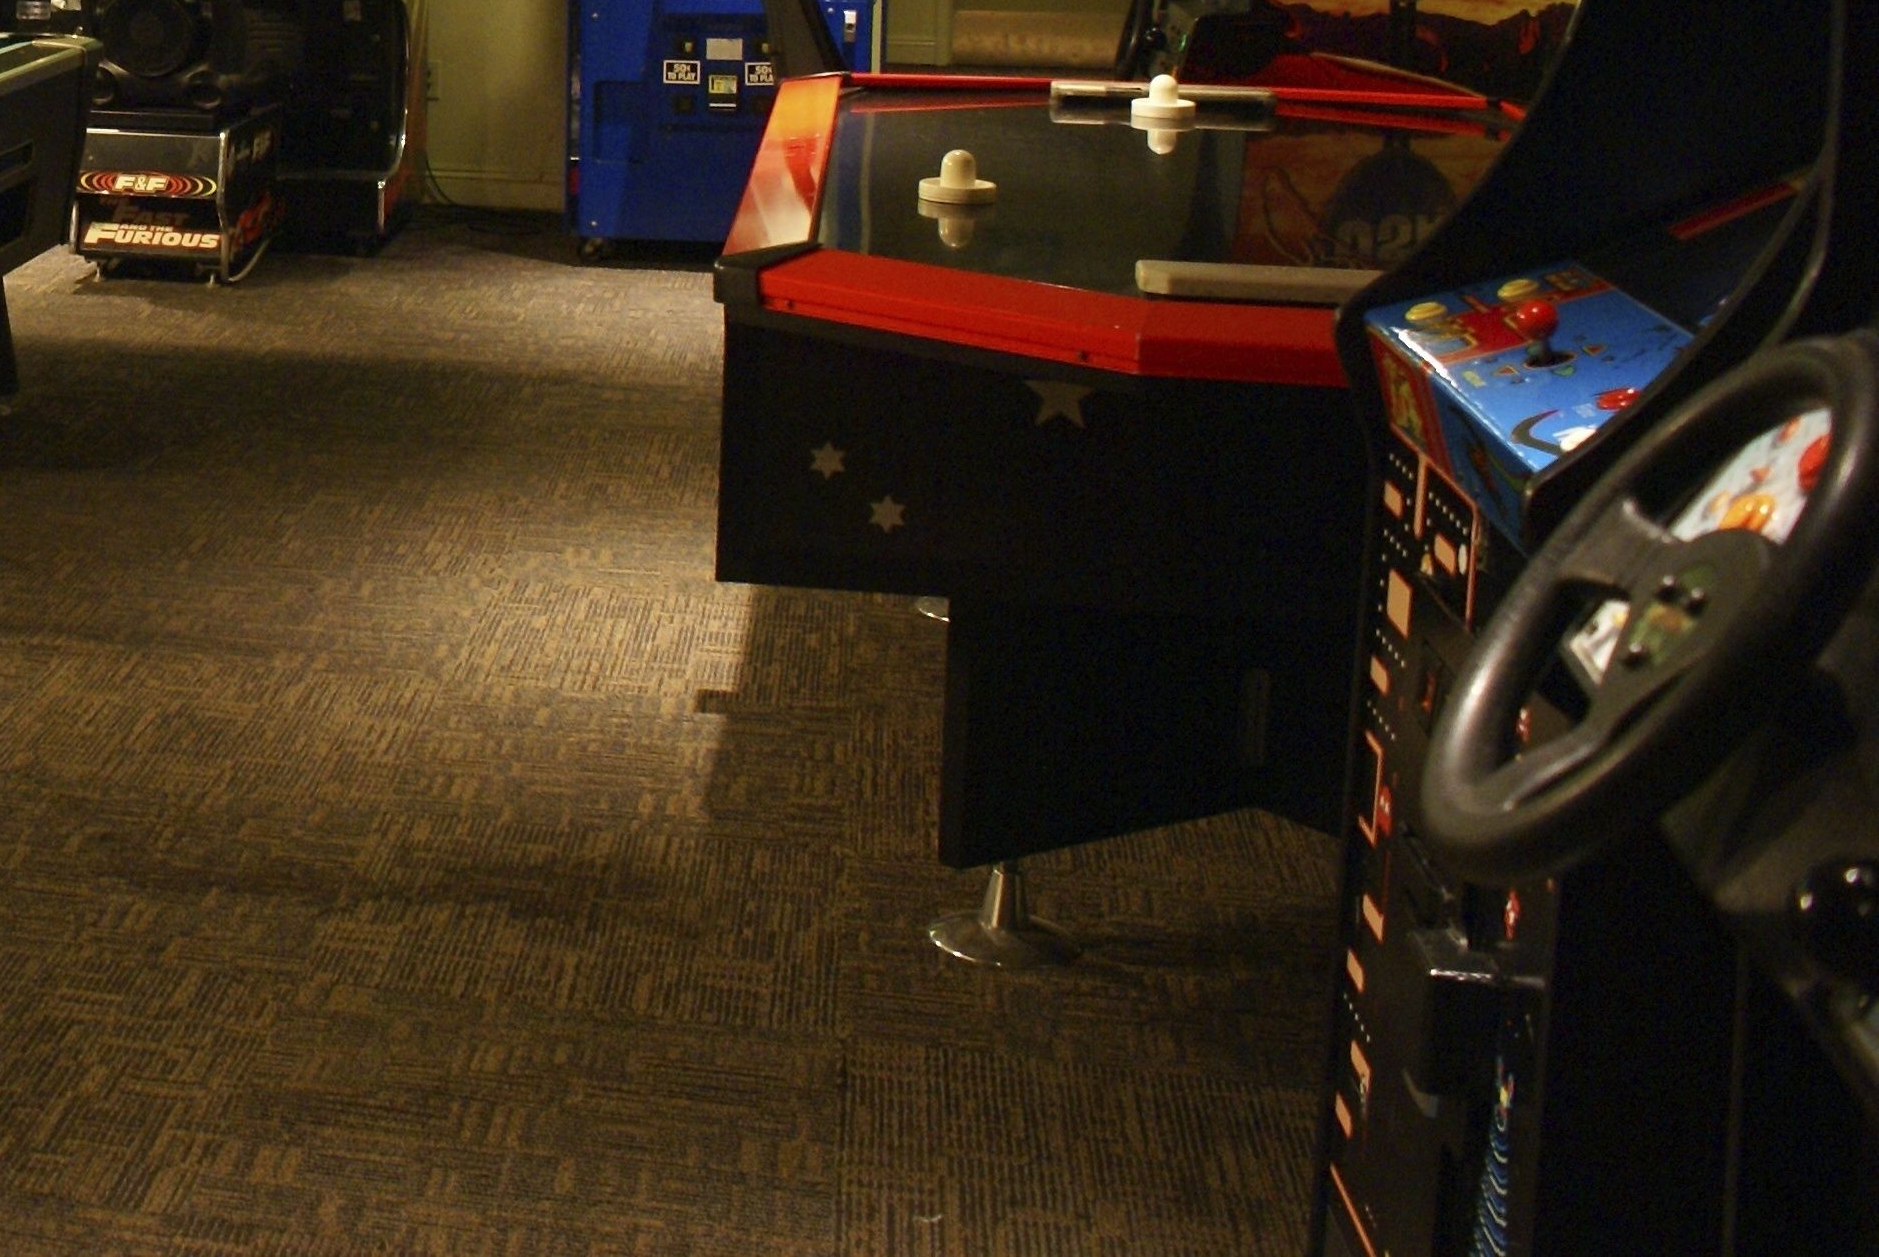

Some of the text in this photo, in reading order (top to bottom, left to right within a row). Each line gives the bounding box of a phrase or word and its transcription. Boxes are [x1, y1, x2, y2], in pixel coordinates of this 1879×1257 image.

[667, 72, 697, 81] TO PLAY
[760, 74, 775, 83] PLA
[112, 174, 170, 193] F&F
[83, 222, 221, 249] FURIOUS
